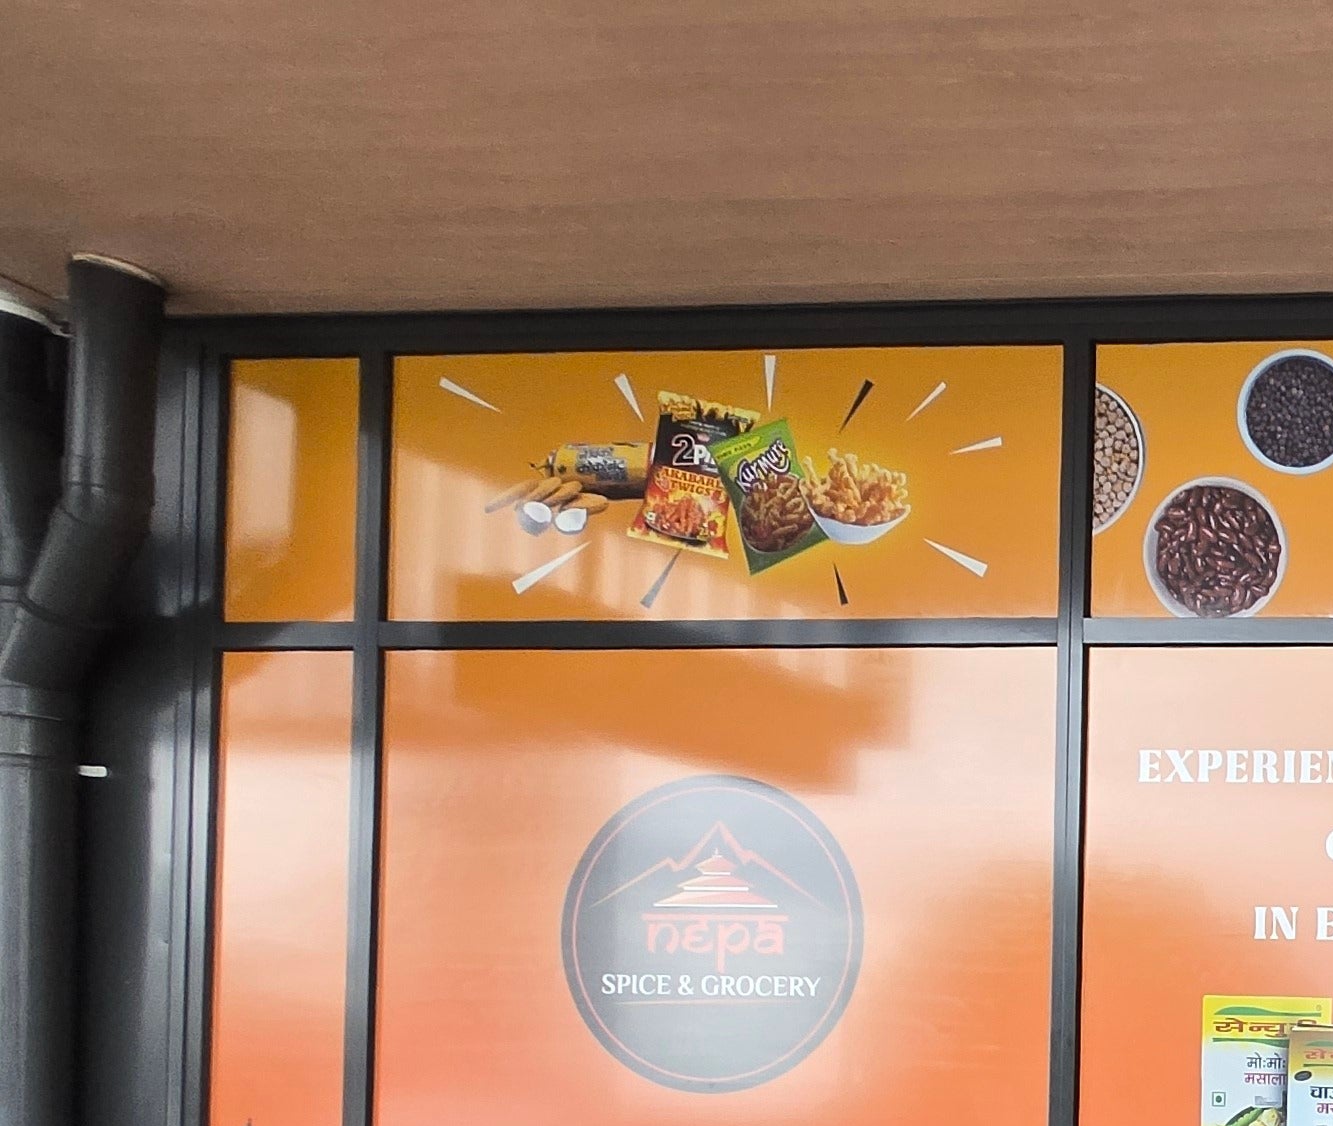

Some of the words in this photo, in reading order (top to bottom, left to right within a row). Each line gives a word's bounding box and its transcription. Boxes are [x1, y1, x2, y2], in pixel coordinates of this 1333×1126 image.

[1252, 906, 1299, 941] IN
[601, 973, 672, 996] SPICE
[677, 975, 695, 996] &
[701, 975, 822, 997] GROCERY
